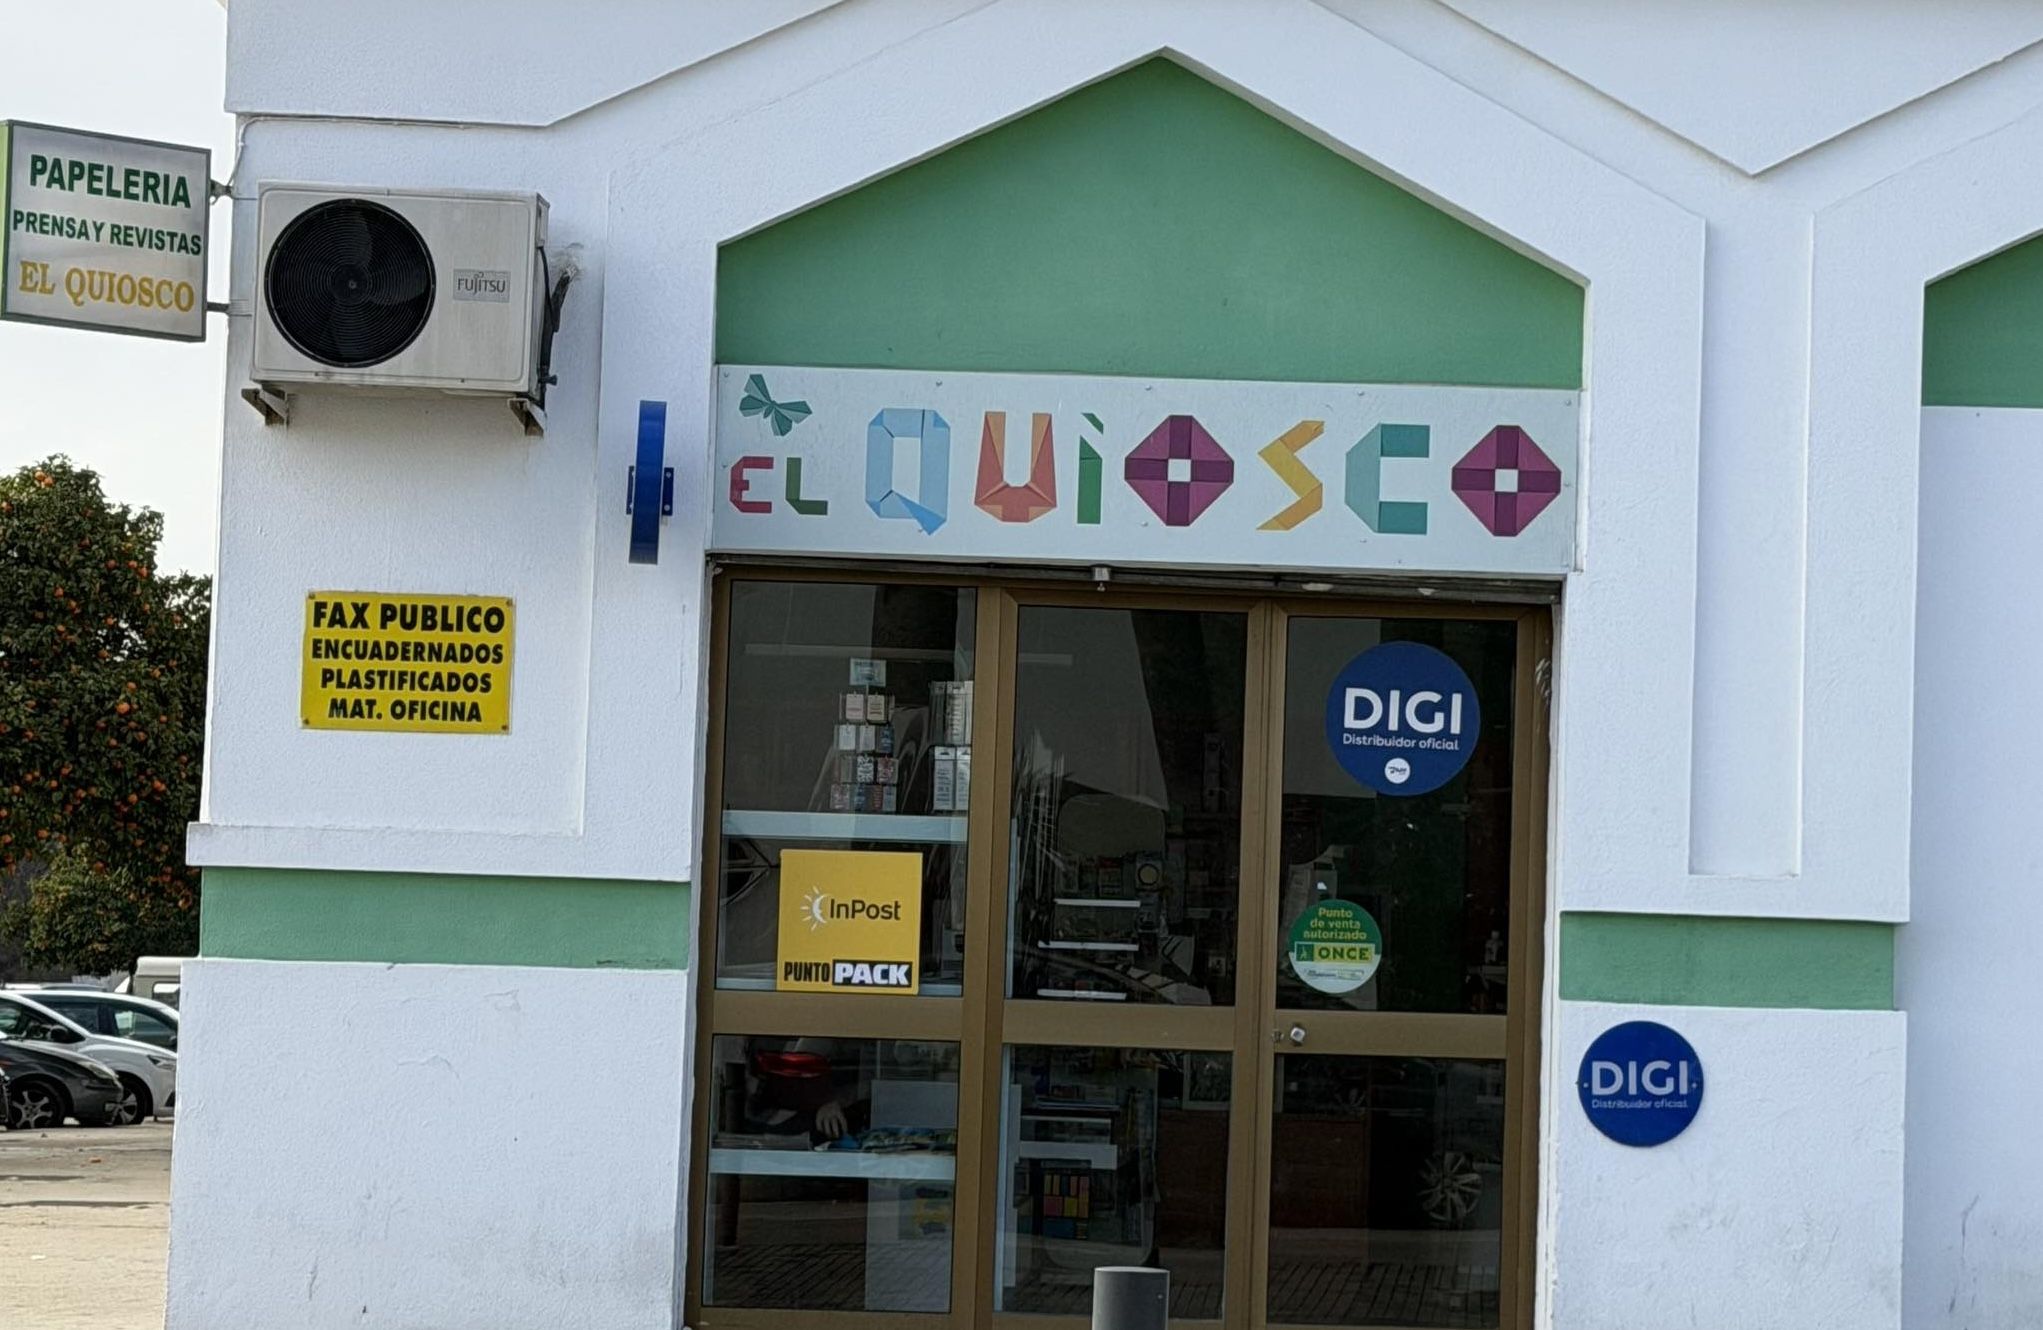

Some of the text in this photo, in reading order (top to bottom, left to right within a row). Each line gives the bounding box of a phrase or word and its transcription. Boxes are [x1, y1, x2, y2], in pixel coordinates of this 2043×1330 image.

[29, 154, 192, 209] PAPELERIA
[109, 223, 202, 256] REVISTAS
[18, 260, 195, 313] EL QUIOSCO
[730, 455, 828, 516] EL
[313, 601, 506, 634] FAX PUBLICO
[311, 638, 504, 665] ENCUADERNADOS
[321, 667, 493, 693] PLASTIFICADOS
[328, 698, 482, 723] MAT. OFICINA
[1344, 687, 1463, 734] DIGI
[1343, 733, 1460, 751] Distribuidor oficial
[829, 898, 902, 921] InPost
[1318, 907, 1354, 918] Punto
[1303, 929, 1367, 940] autorizado
[1310, 918, 1361, 930] de venta
[1318, 947, 1370, 960] ONCE
[783, 961, 910, 985] PUNTO PACK
[1592, 1060, 1689, 1096] DIGI
[1591, 1099, 1652, 1109] Distribuidor
